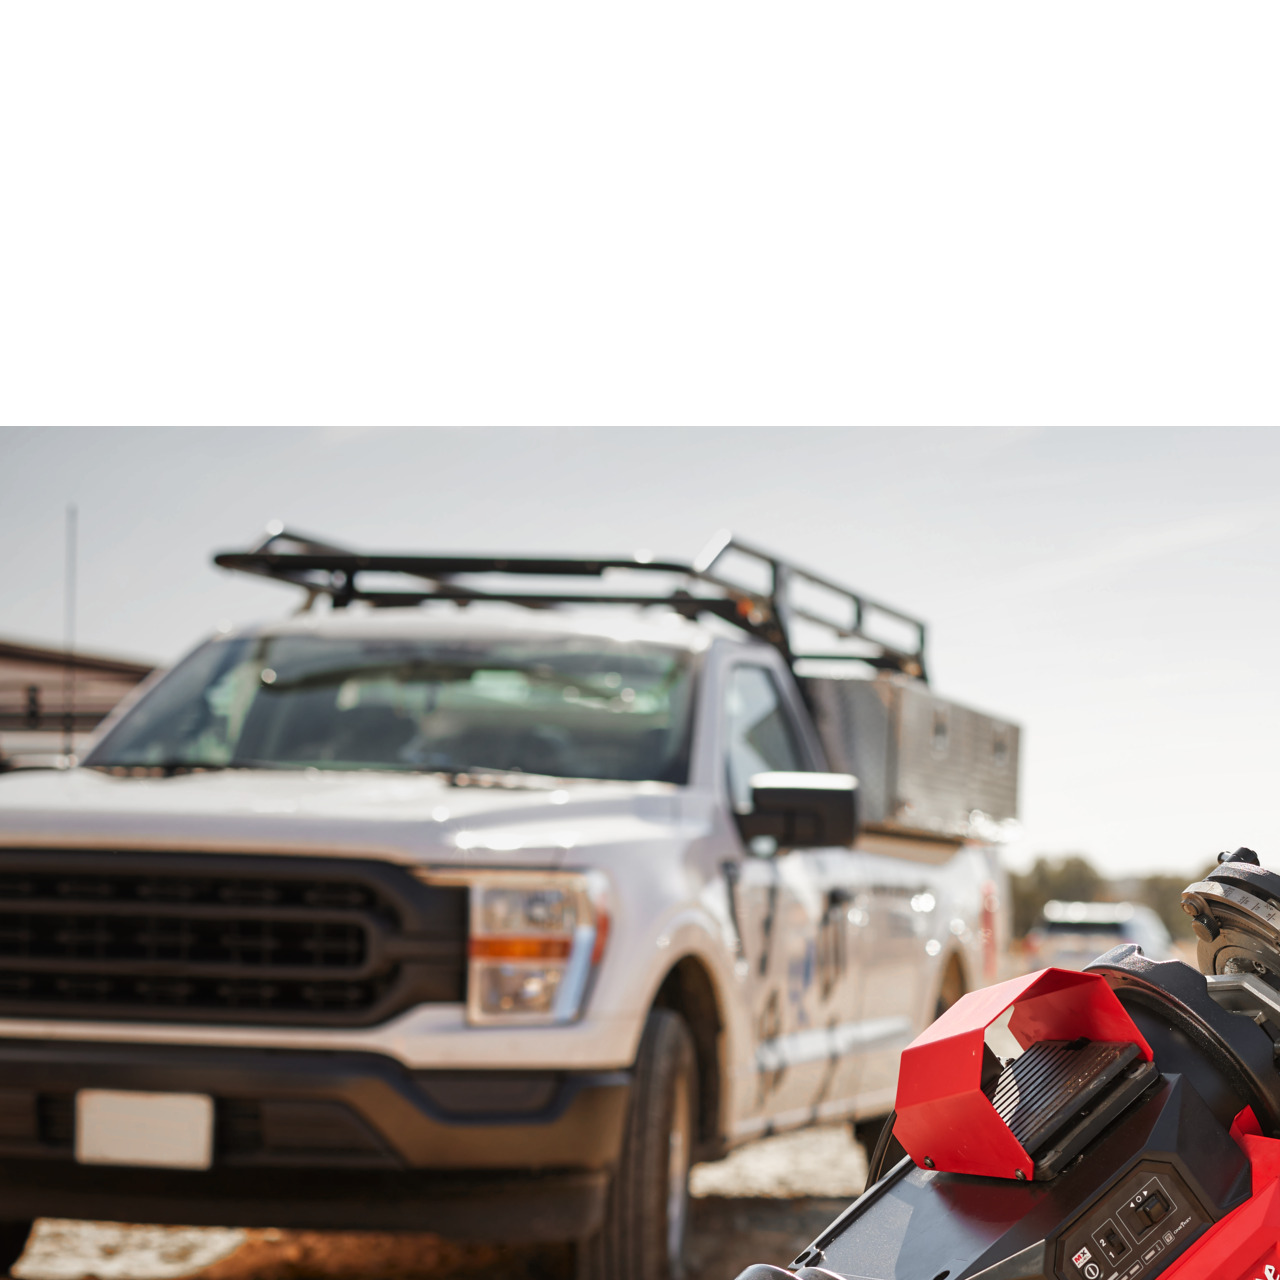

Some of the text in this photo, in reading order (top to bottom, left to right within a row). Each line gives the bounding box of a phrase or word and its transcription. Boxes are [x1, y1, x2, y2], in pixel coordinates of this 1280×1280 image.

[1099, 1238, 1107, 1247] 2
[1073, 1249, 1088, 1263] MX
[1108, 1250, 1115, 1259] 1
